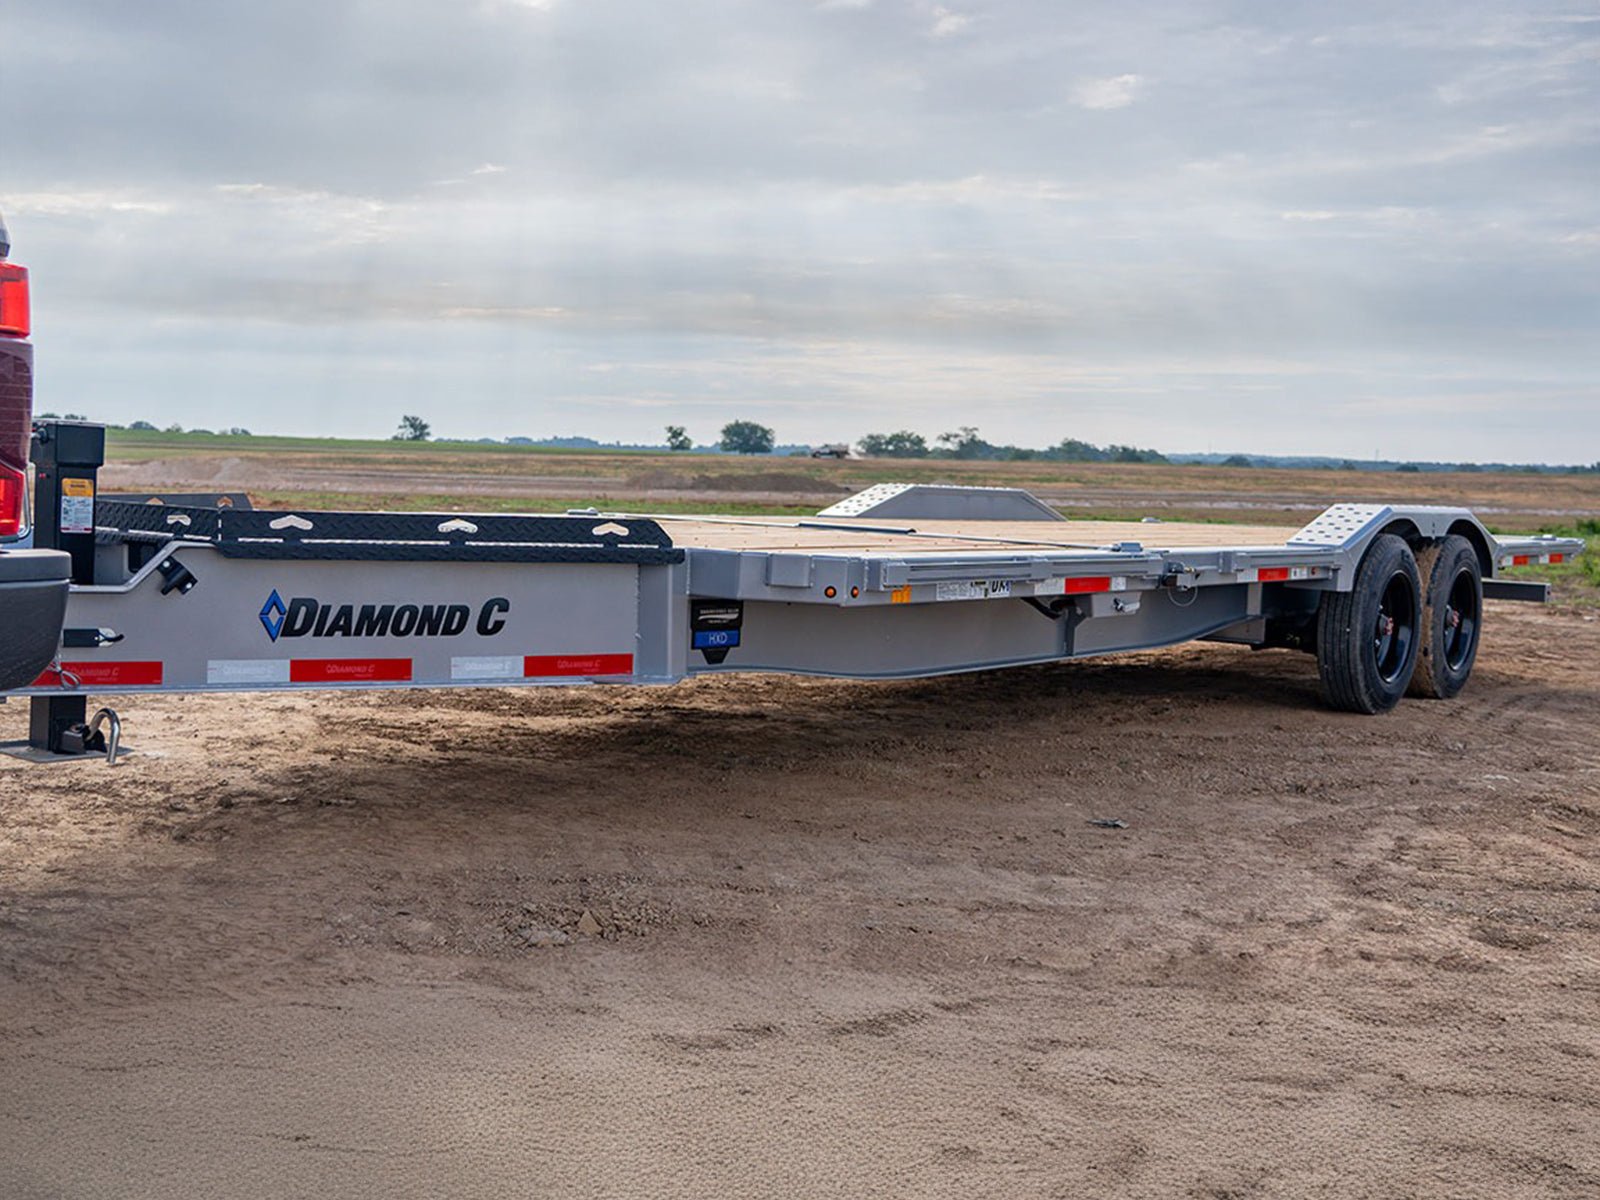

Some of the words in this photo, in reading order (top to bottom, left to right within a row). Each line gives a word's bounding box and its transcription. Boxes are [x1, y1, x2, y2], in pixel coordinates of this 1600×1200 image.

[281, 598, 470, 637] DIAMOND
[477, 597, 510, 636] C
[332, 664, 367, 673] DIAMOND
